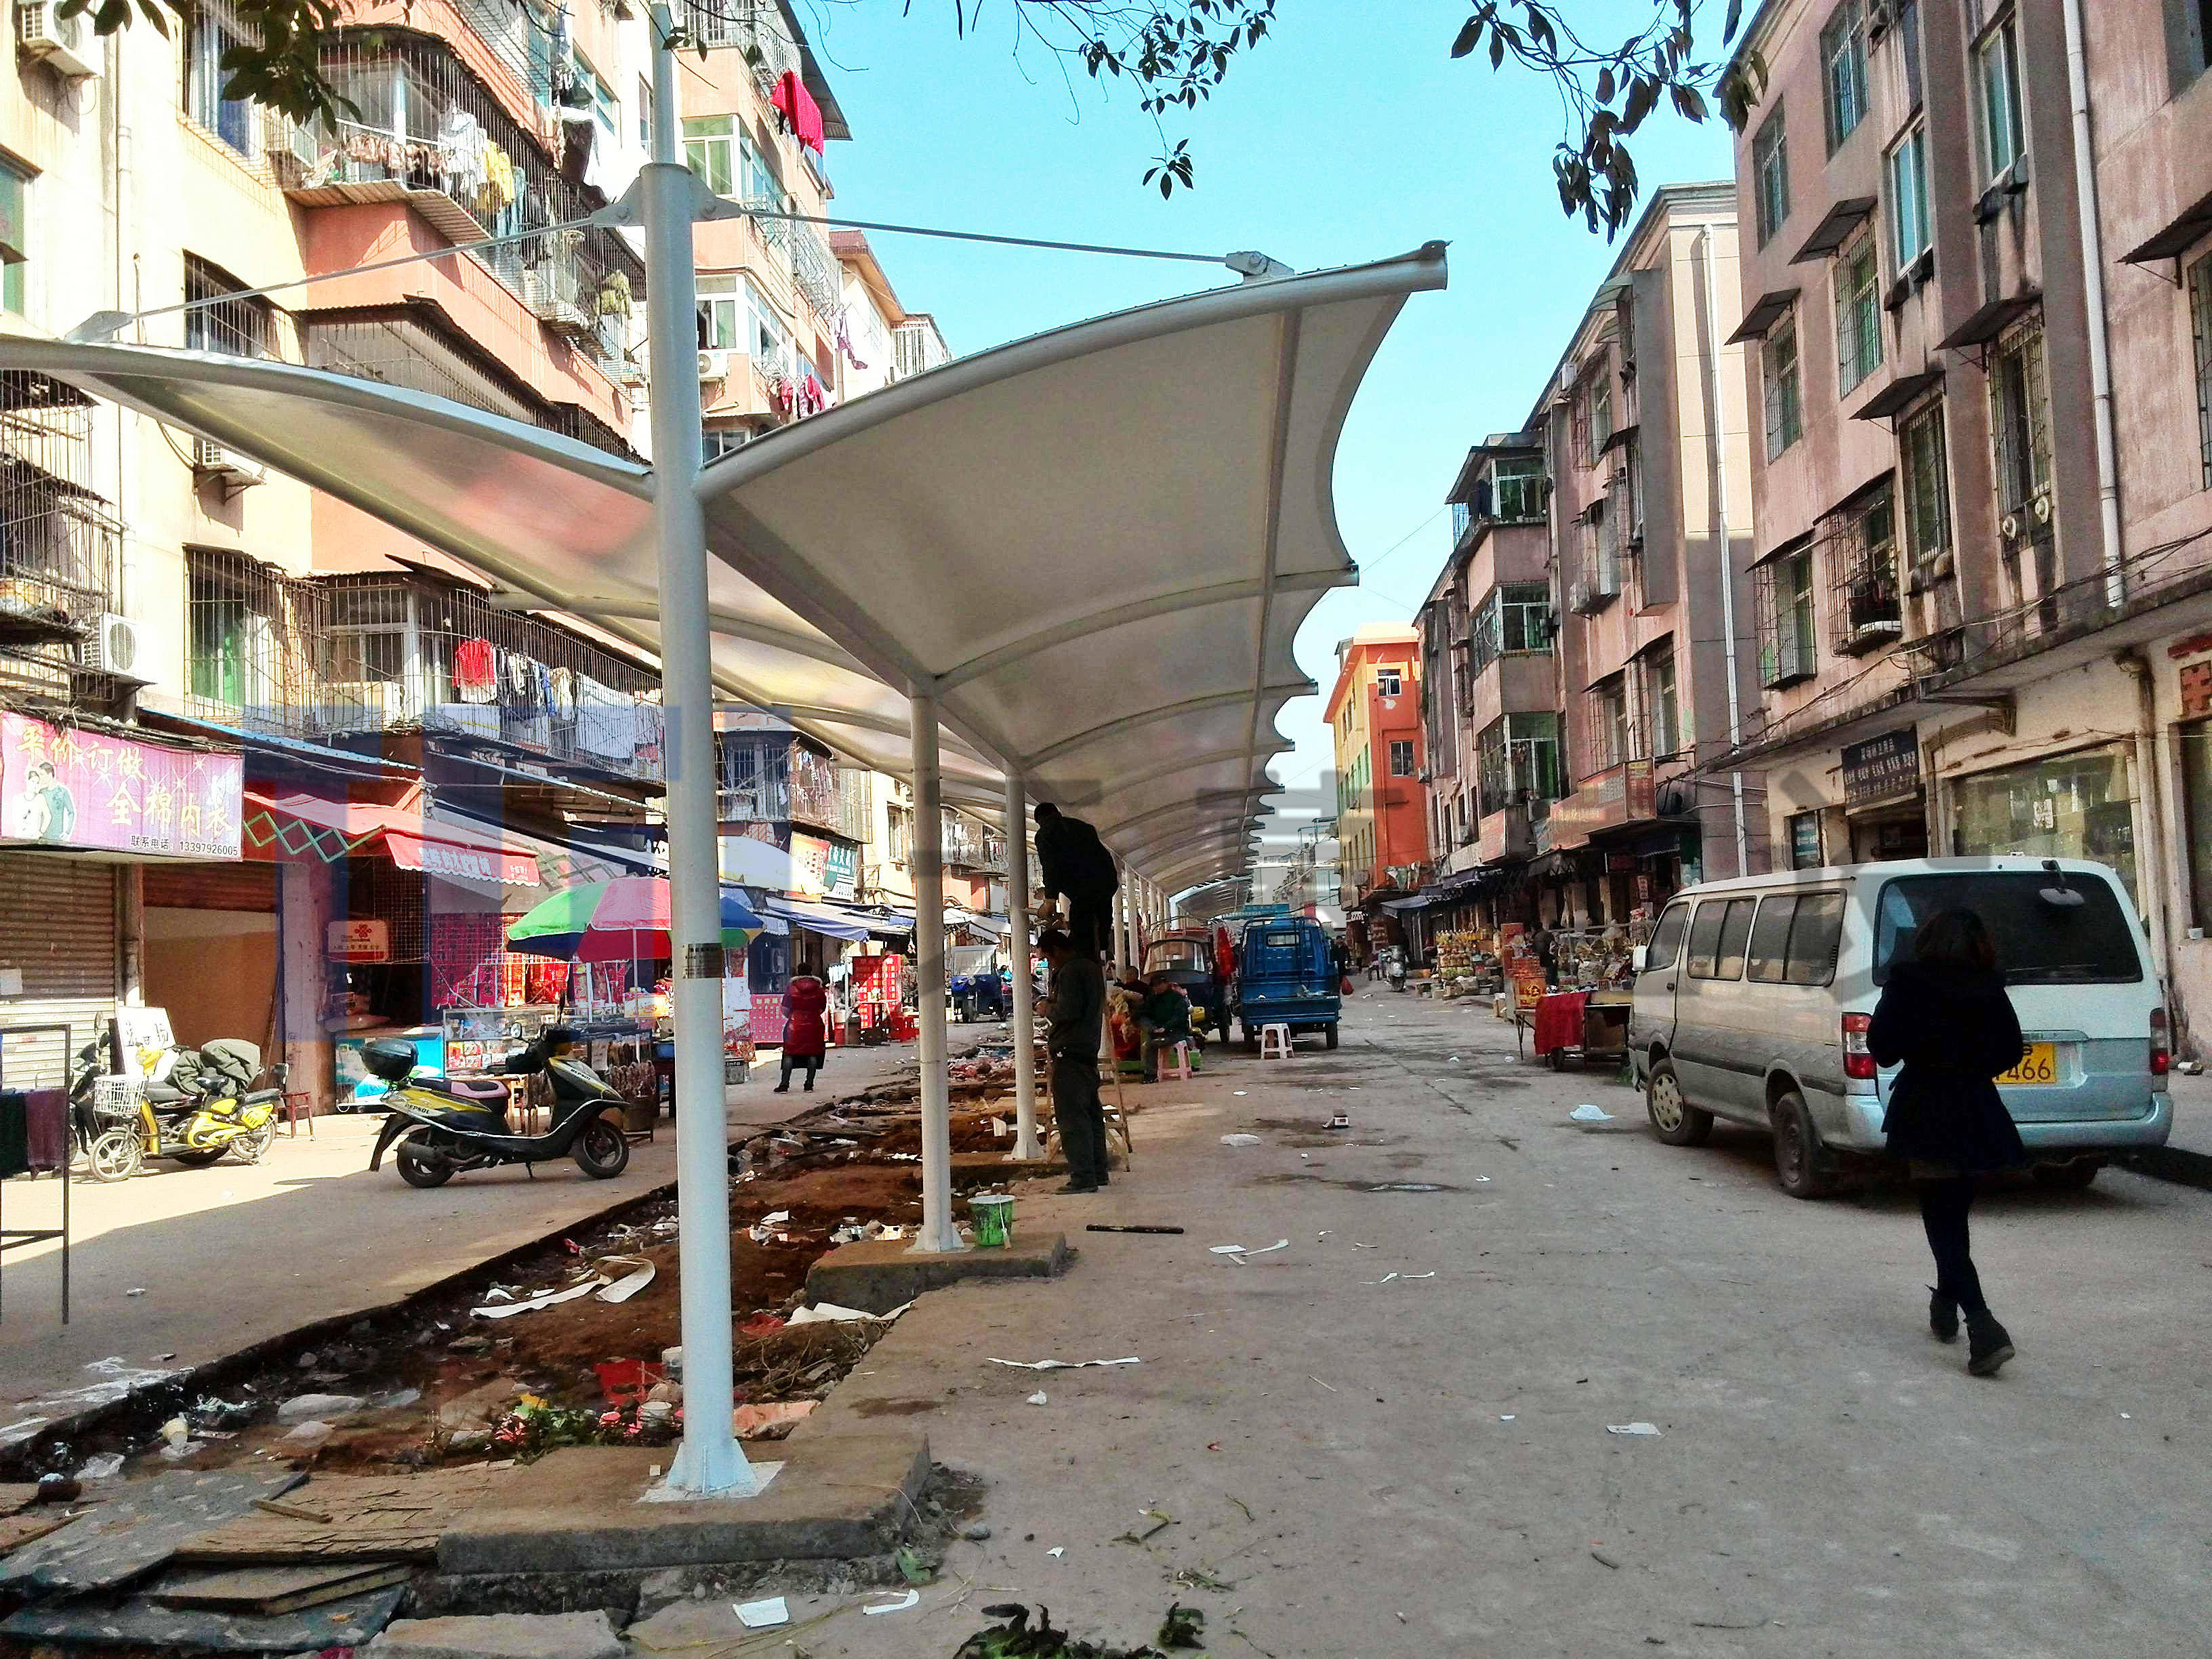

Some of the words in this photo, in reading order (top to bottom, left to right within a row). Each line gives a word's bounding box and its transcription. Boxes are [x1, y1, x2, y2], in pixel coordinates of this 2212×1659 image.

[106, 781, 234, 840] 全棉内衣
[180, 841, 238, 856] 13397926005
